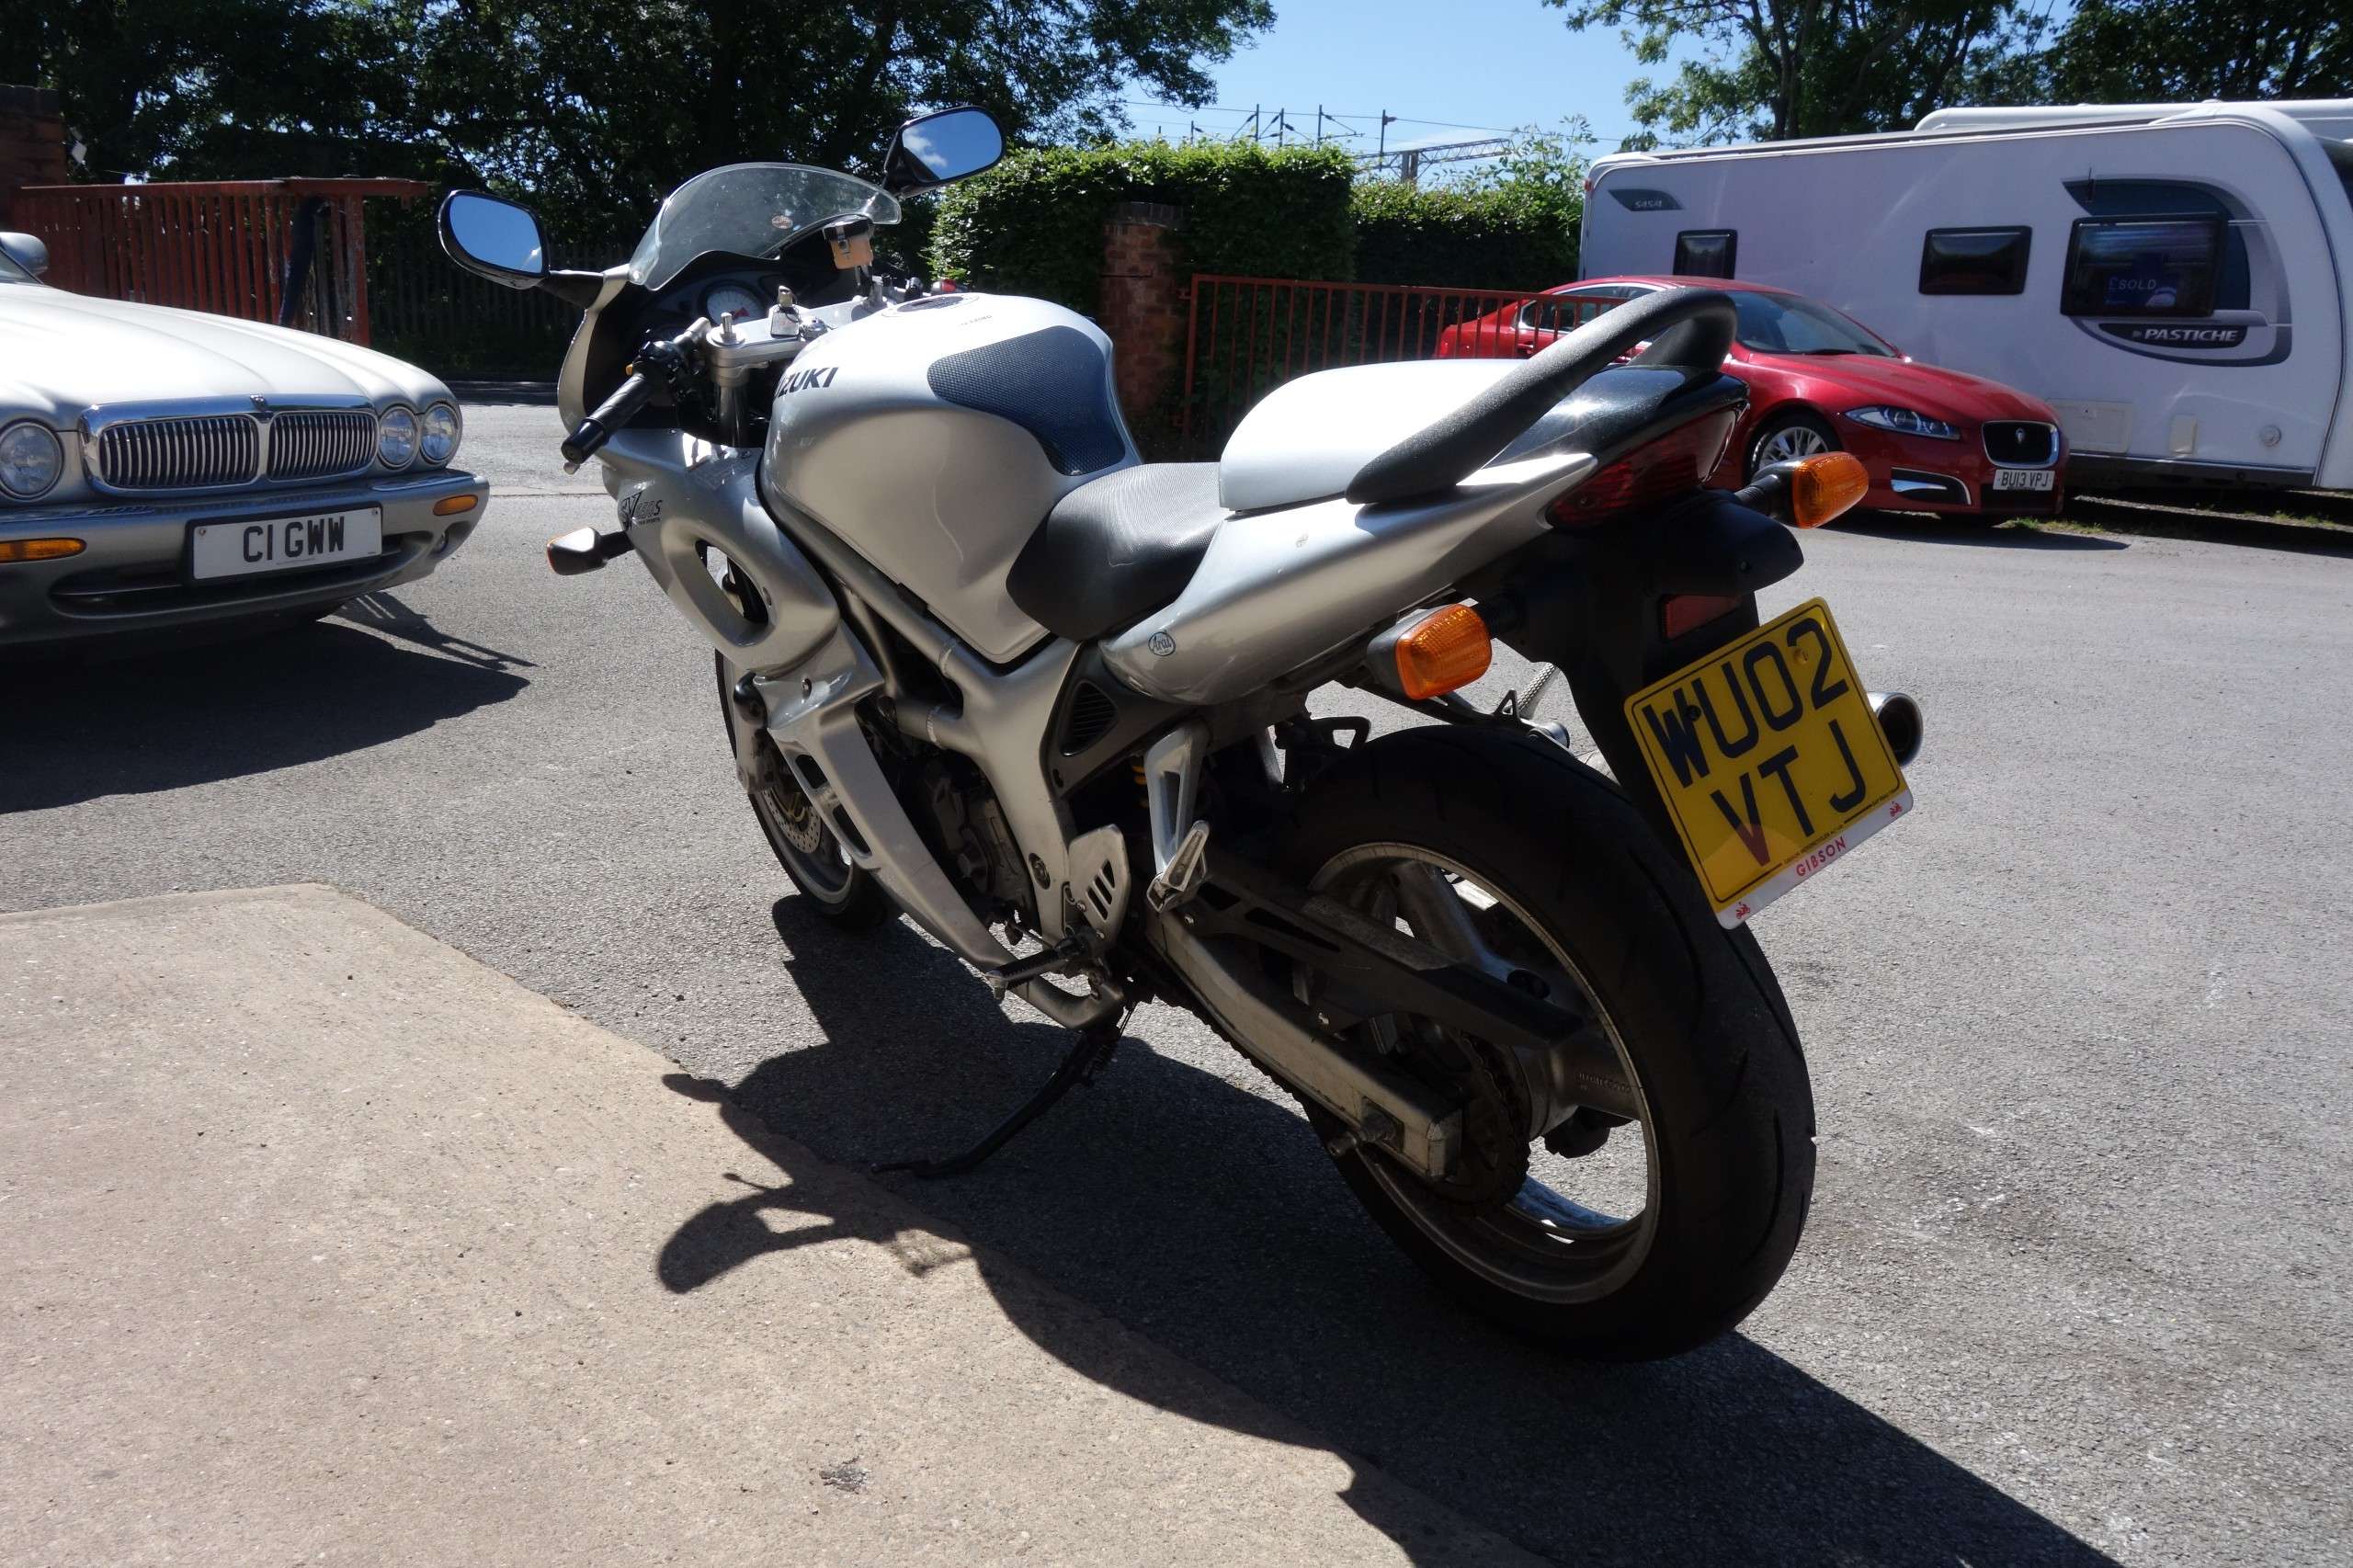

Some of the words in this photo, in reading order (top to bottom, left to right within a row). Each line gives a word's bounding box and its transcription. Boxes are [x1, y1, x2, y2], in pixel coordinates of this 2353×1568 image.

[2144, 328, 2238, 342] PASTICHE
[2029, 472, 2049, 487] VPJ
[284, 516, 345, 558] GWW
[1710, 719, 1867, 867] VTJ
[1796, 835, 1847, 877] GIBSON
